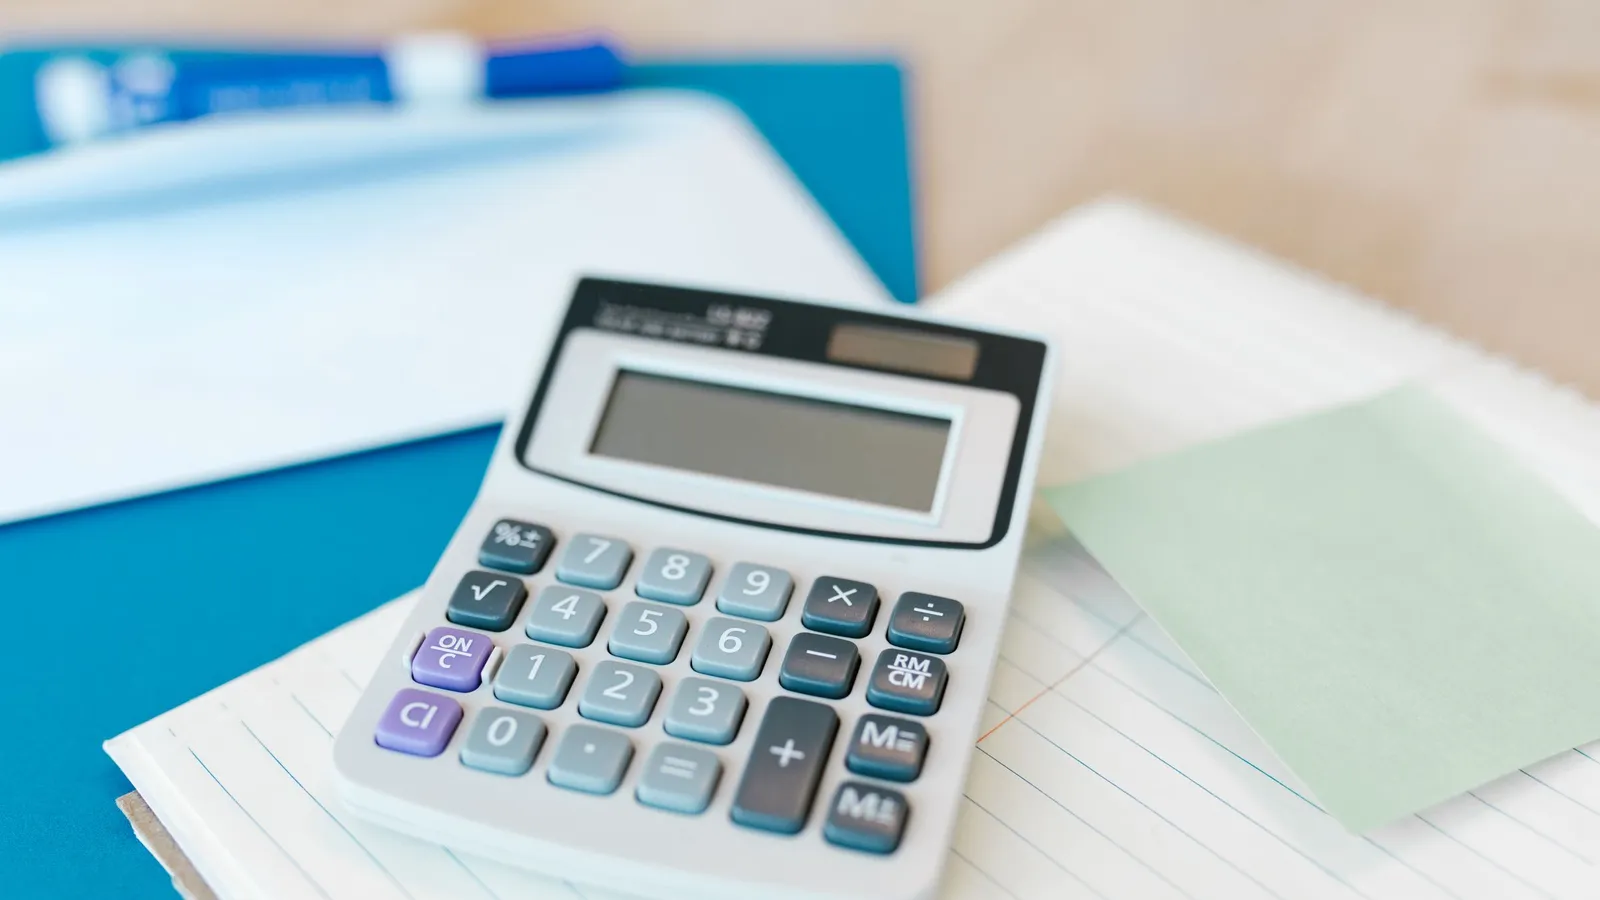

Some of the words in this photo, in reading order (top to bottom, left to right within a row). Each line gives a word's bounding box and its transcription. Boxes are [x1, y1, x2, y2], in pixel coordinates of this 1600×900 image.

[583, 538, 612, 564] 7
[660, 554, 691, 580] 8
[742, 570, 771, 596] 9
[550, 595, 582, 621] 4
[632, 609, 664, 636] 5
[438, 634, 473, 652] ON
[717, 627, 747, 654] 6
[438, 653, 456, 669] C
[528, 653, 547, 681] 1
[893, 653, 931, 672] RM
[602, 669, 635, 700] 2
[887, 671, 924, 690] CM
[688, 686, 720, 716] 3
